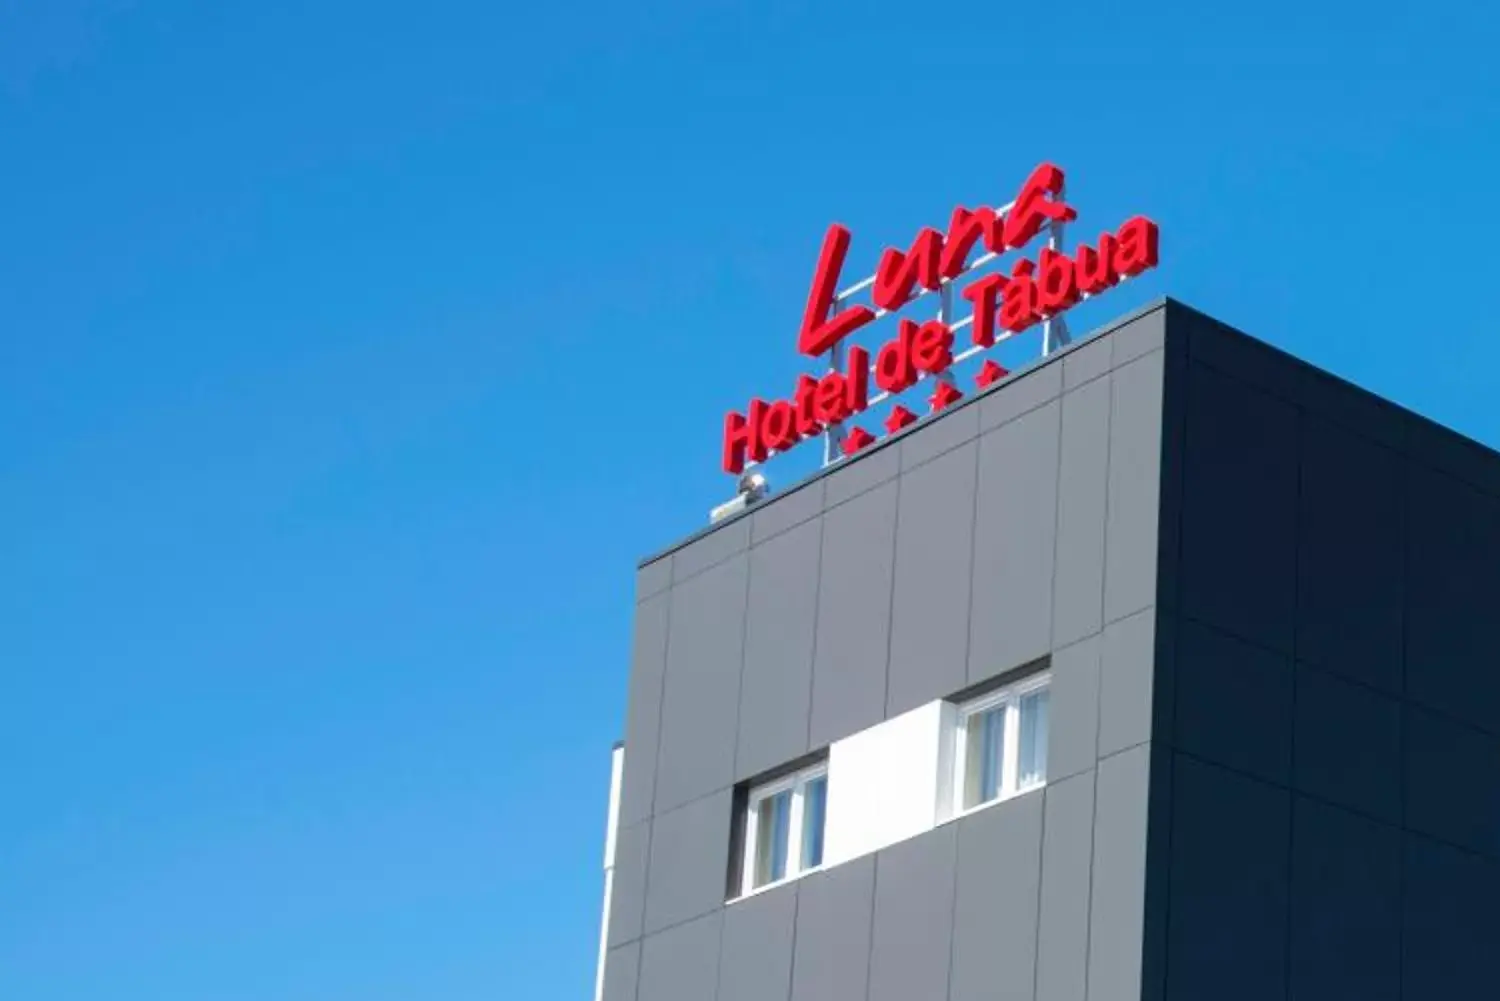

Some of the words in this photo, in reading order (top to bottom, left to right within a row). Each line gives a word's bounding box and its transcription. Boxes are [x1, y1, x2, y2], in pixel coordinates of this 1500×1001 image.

[723, 345, 869, 474] Hotel
[876, 319, 953, 393] de
[962, 215, 1159, 348] Tábua
[798, 161, 1077, 357] Luna
